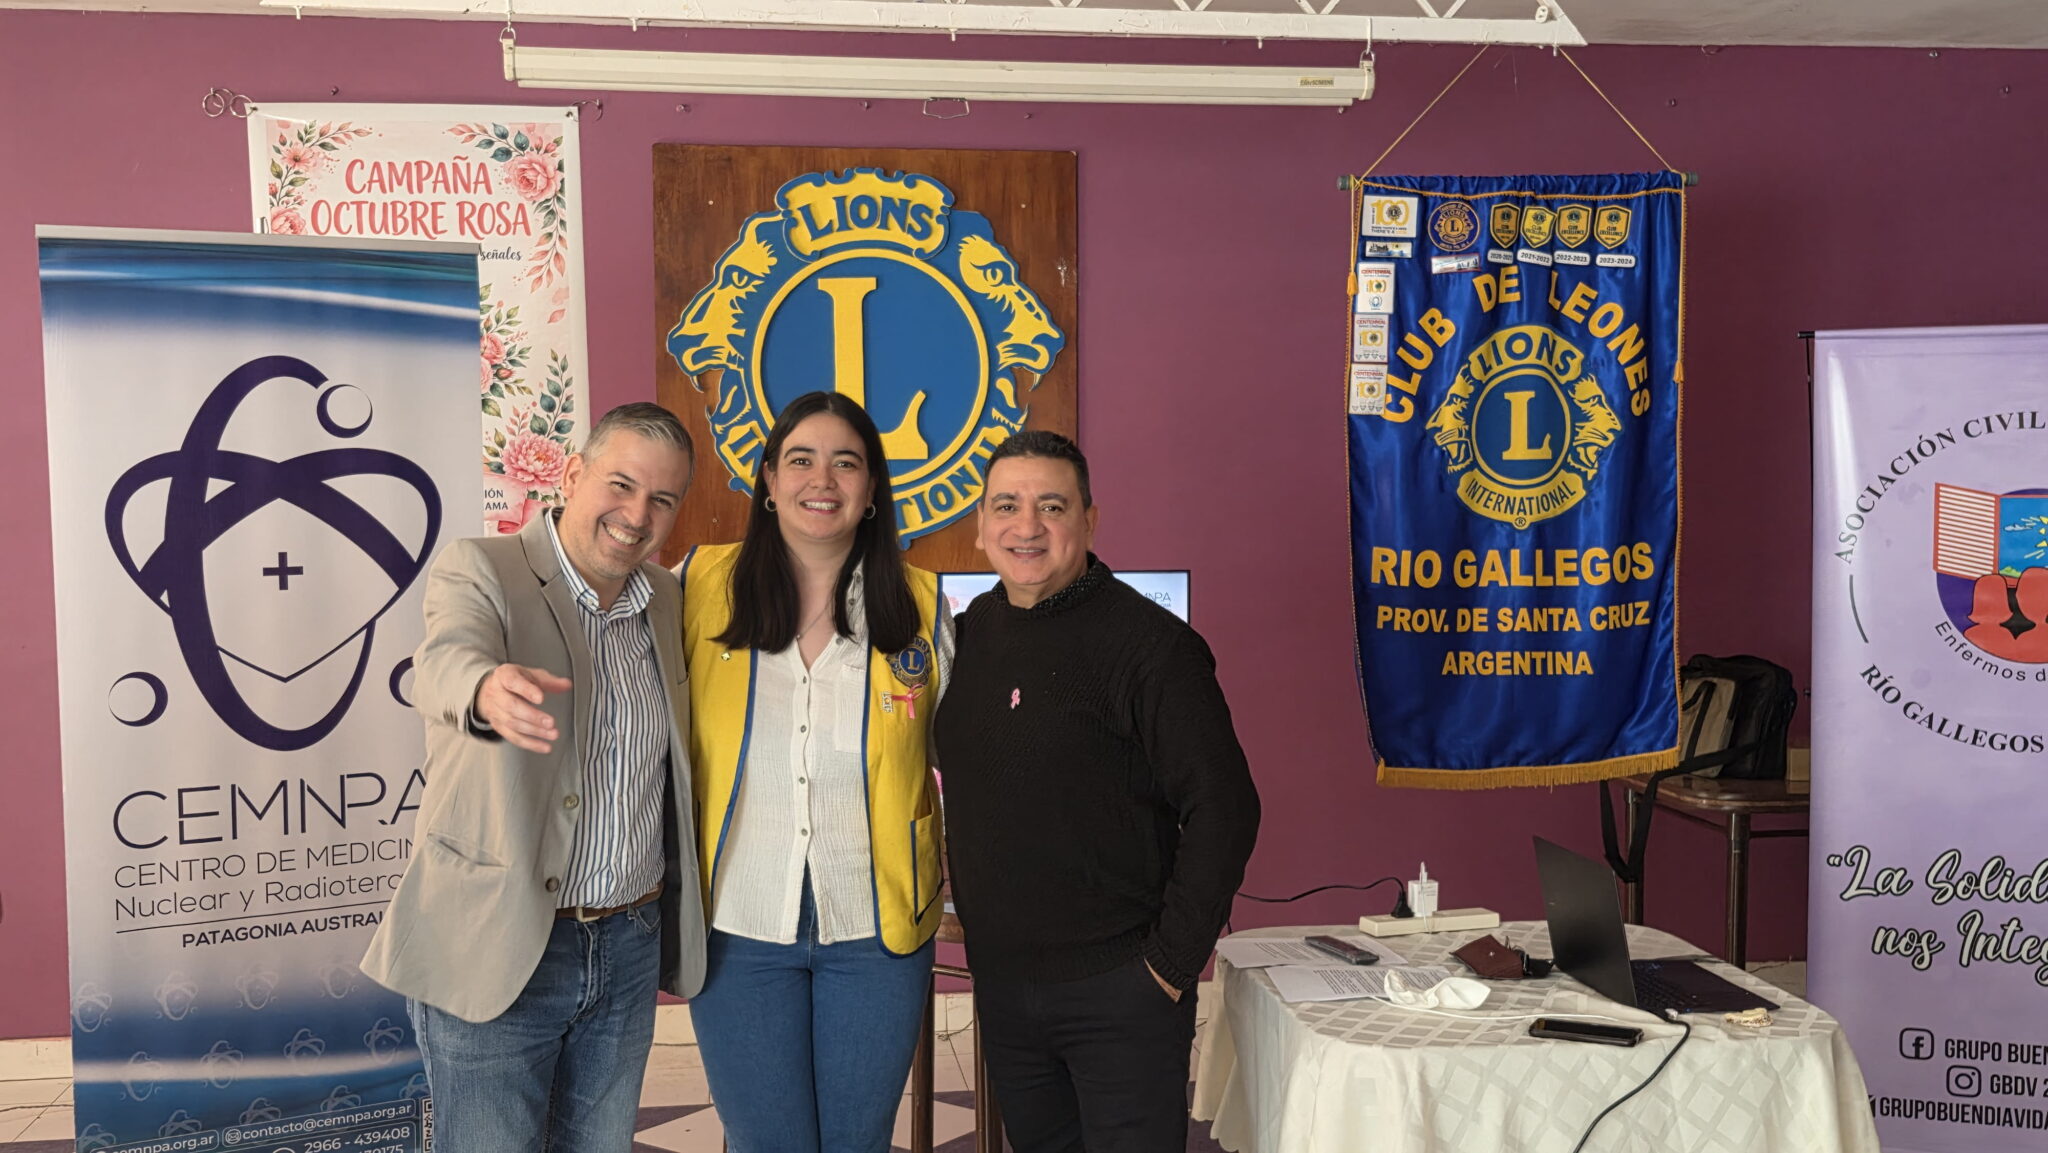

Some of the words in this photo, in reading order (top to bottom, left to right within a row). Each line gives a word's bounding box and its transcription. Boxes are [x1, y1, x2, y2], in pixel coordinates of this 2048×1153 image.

[345, 156, 493, 196] CAMPAÑA
[311, 200, 448, 240] OCTUBRE
[457, 200, 531, 240] ROSA
[797, 194, 935, 242] LIONS
[1382, 307, 1457, 422] CLUB
[1472, 265, 1521, 312] DE
[1548, 271, 1651, 417] LEONES
[1478, 332, 1577, 381] LIONS
[817, 276, 929, 459] L
[1502, 391, 1552, 460] L
[1466, 478, 1576, 516] INTERNATIONAL
[1834, 428, 1956, 565] ASOCIACIÓN
[1963, 410, 2046, 439] CIVIL
[1370, 547, 1442, 588] RIO
[1454, 542, 1654, 587] GALLEGOS
[1376, 606, 1449, 633] PROV.
[1456, 608, 1489, 632] DE
[1496, 608, 1582, 632] SANTA
[1590, 601, 1650, 630] CRUZ
[1442, 651, 1594, 675] ARGENTINA
[1935, 621, 2026, 681] Enfermos
[1860, 663, 1902, 704] RÍO
[1903, 700, 2044, 754] GALLEGOS
[113, 769, 426, 849] CEMNPA
[114, 854, 246, 888] CENTRO
[257, 849, 297, 875] DE
[115, 891, 230, 920] Nuclear
[239, 889, 255, 912] y
[183, 922, 297, 947] PATAGONIA
[1872, 926, 1945, 971] nos
[1945, 1038, 2002, 1062] GRUPO
[1990, 1074, 2038, 1098] GBDV
[113, 1134, 214, 1153] mnpa.org.ar
[242, 1104, 412, 1140] contacto@cemnpa.org.ar
[304, 1137, 342, 1153] 2966
[354, 1127, 410, 1146] 439408
